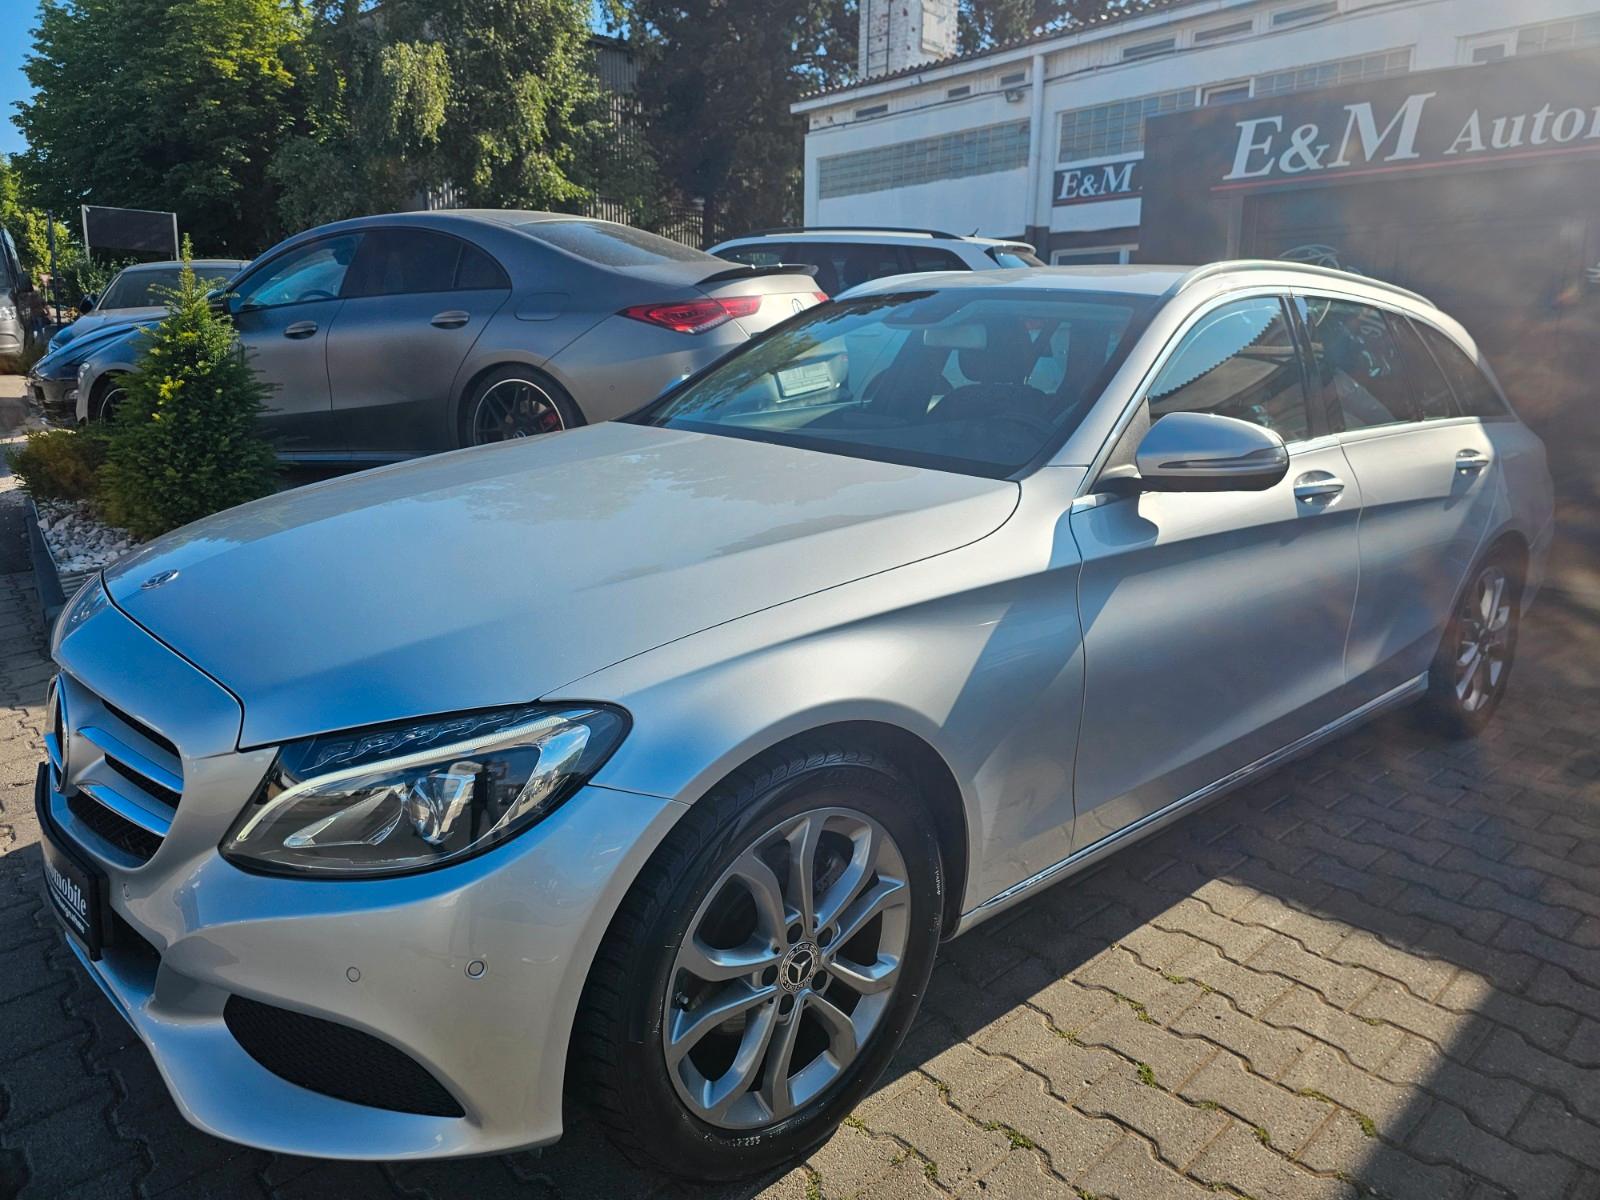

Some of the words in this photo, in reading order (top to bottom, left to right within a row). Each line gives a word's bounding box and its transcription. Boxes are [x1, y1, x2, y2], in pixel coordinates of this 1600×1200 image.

[1222, 92, 1437, 180] E&M
[1057, 162, 1137, 200] E&M
[50, 867, 87, 916] mobile
